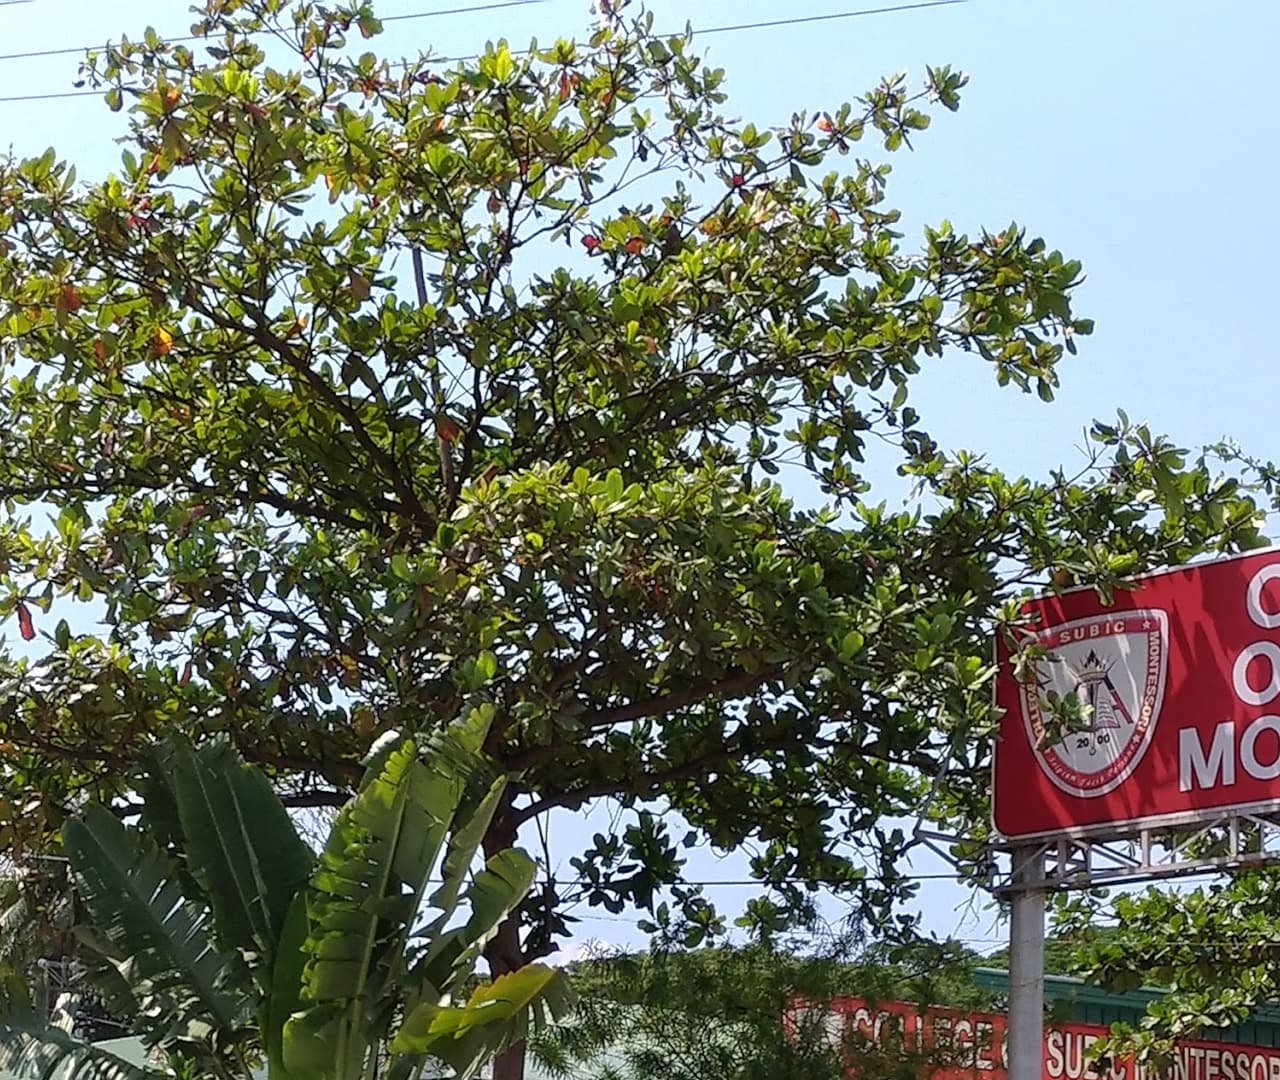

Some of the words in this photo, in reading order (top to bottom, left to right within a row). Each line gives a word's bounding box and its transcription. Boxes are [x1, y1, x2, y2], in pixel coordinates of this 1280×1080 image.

[1059, 620, 1125, 644] SUBIC
[1136, 631, 1160, 732] MONTESSORI
[1076, 737, 1090, 749] 20
[1097, 733, 1110, 745] 00
